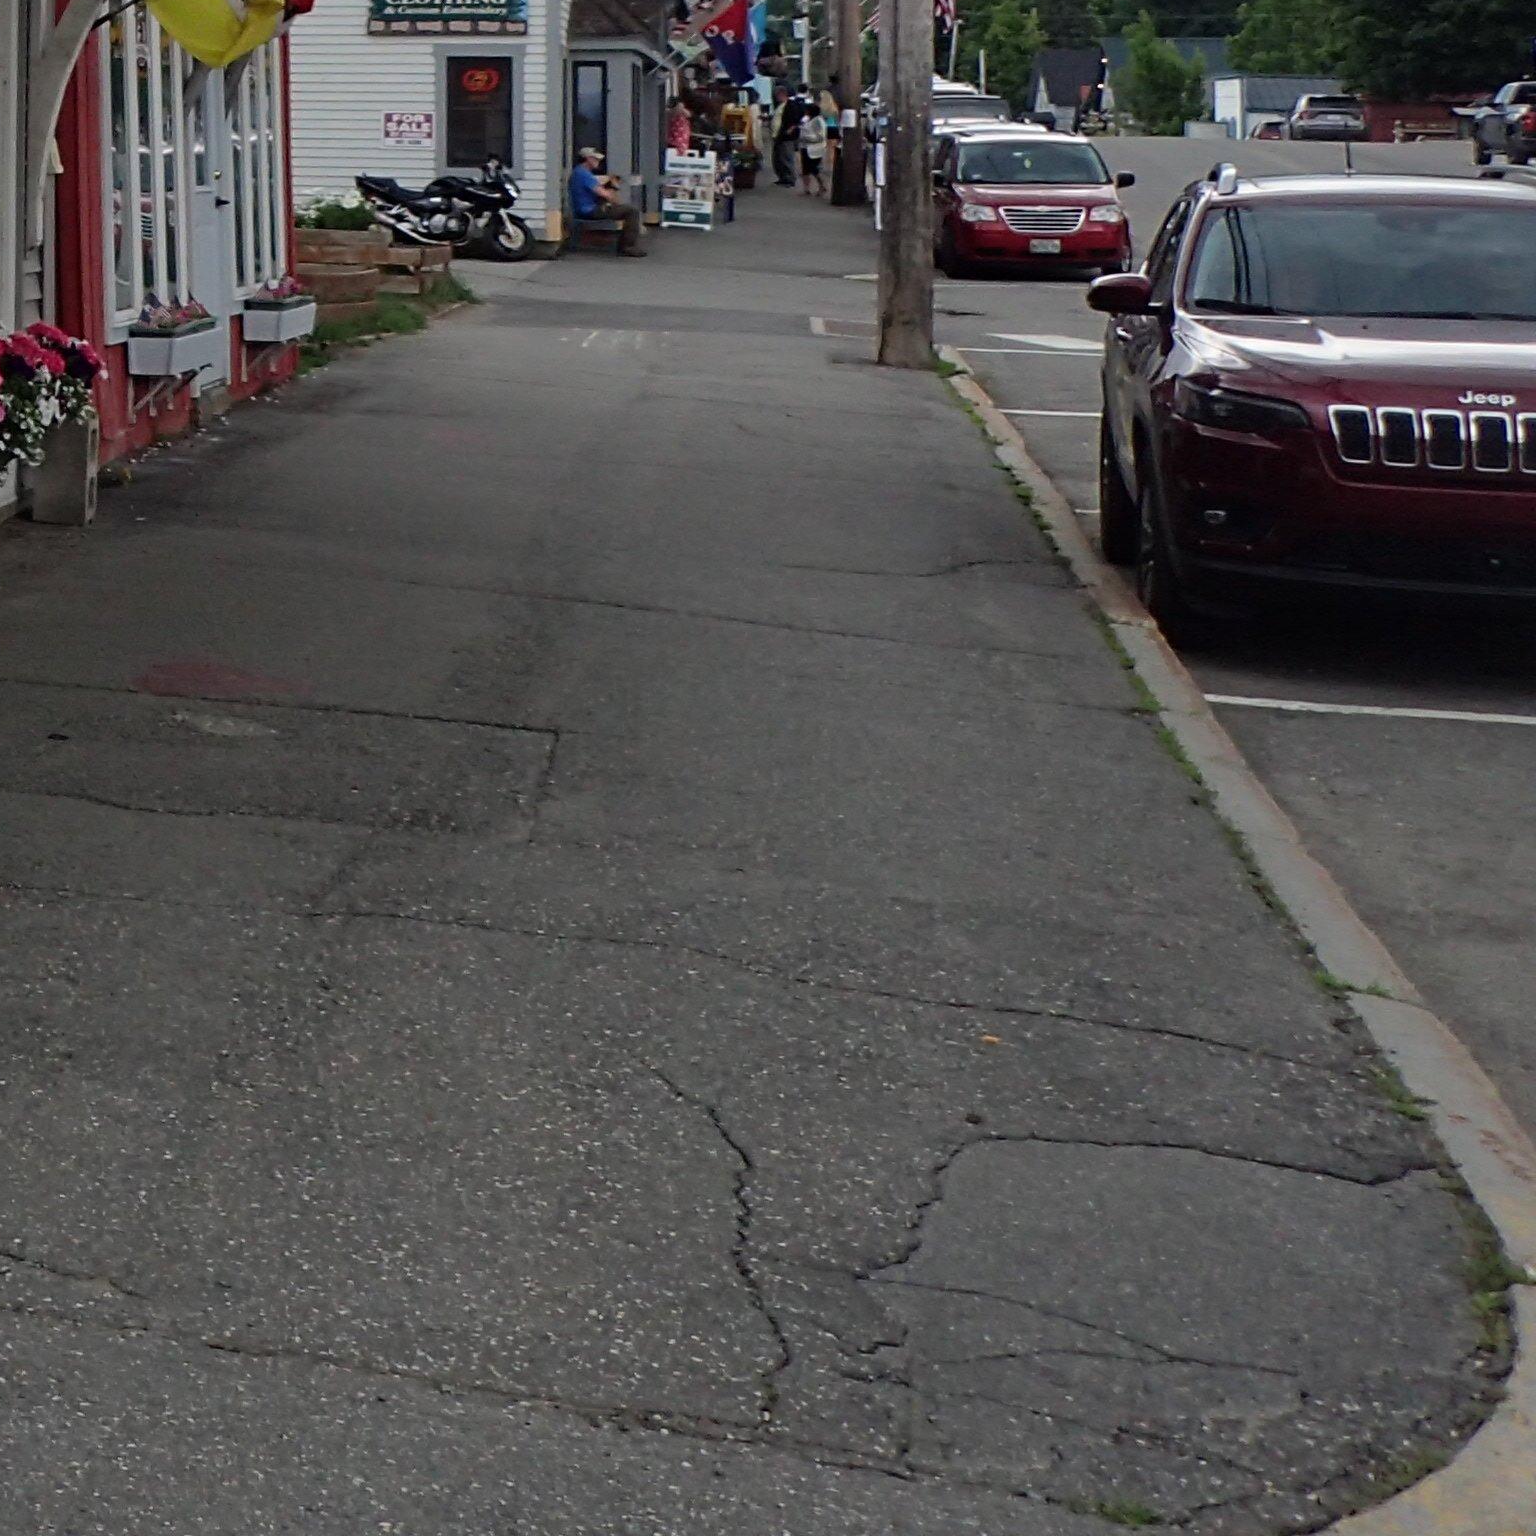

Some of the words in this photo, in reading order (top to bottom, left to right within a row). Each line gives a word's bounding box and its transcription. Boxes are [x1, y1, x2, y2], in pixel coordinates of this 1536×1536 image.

[392, 114, 424, 123] FOR
[386, 122, 431, 132] SALE
[1458, 390, 1516, 407] Jeep
